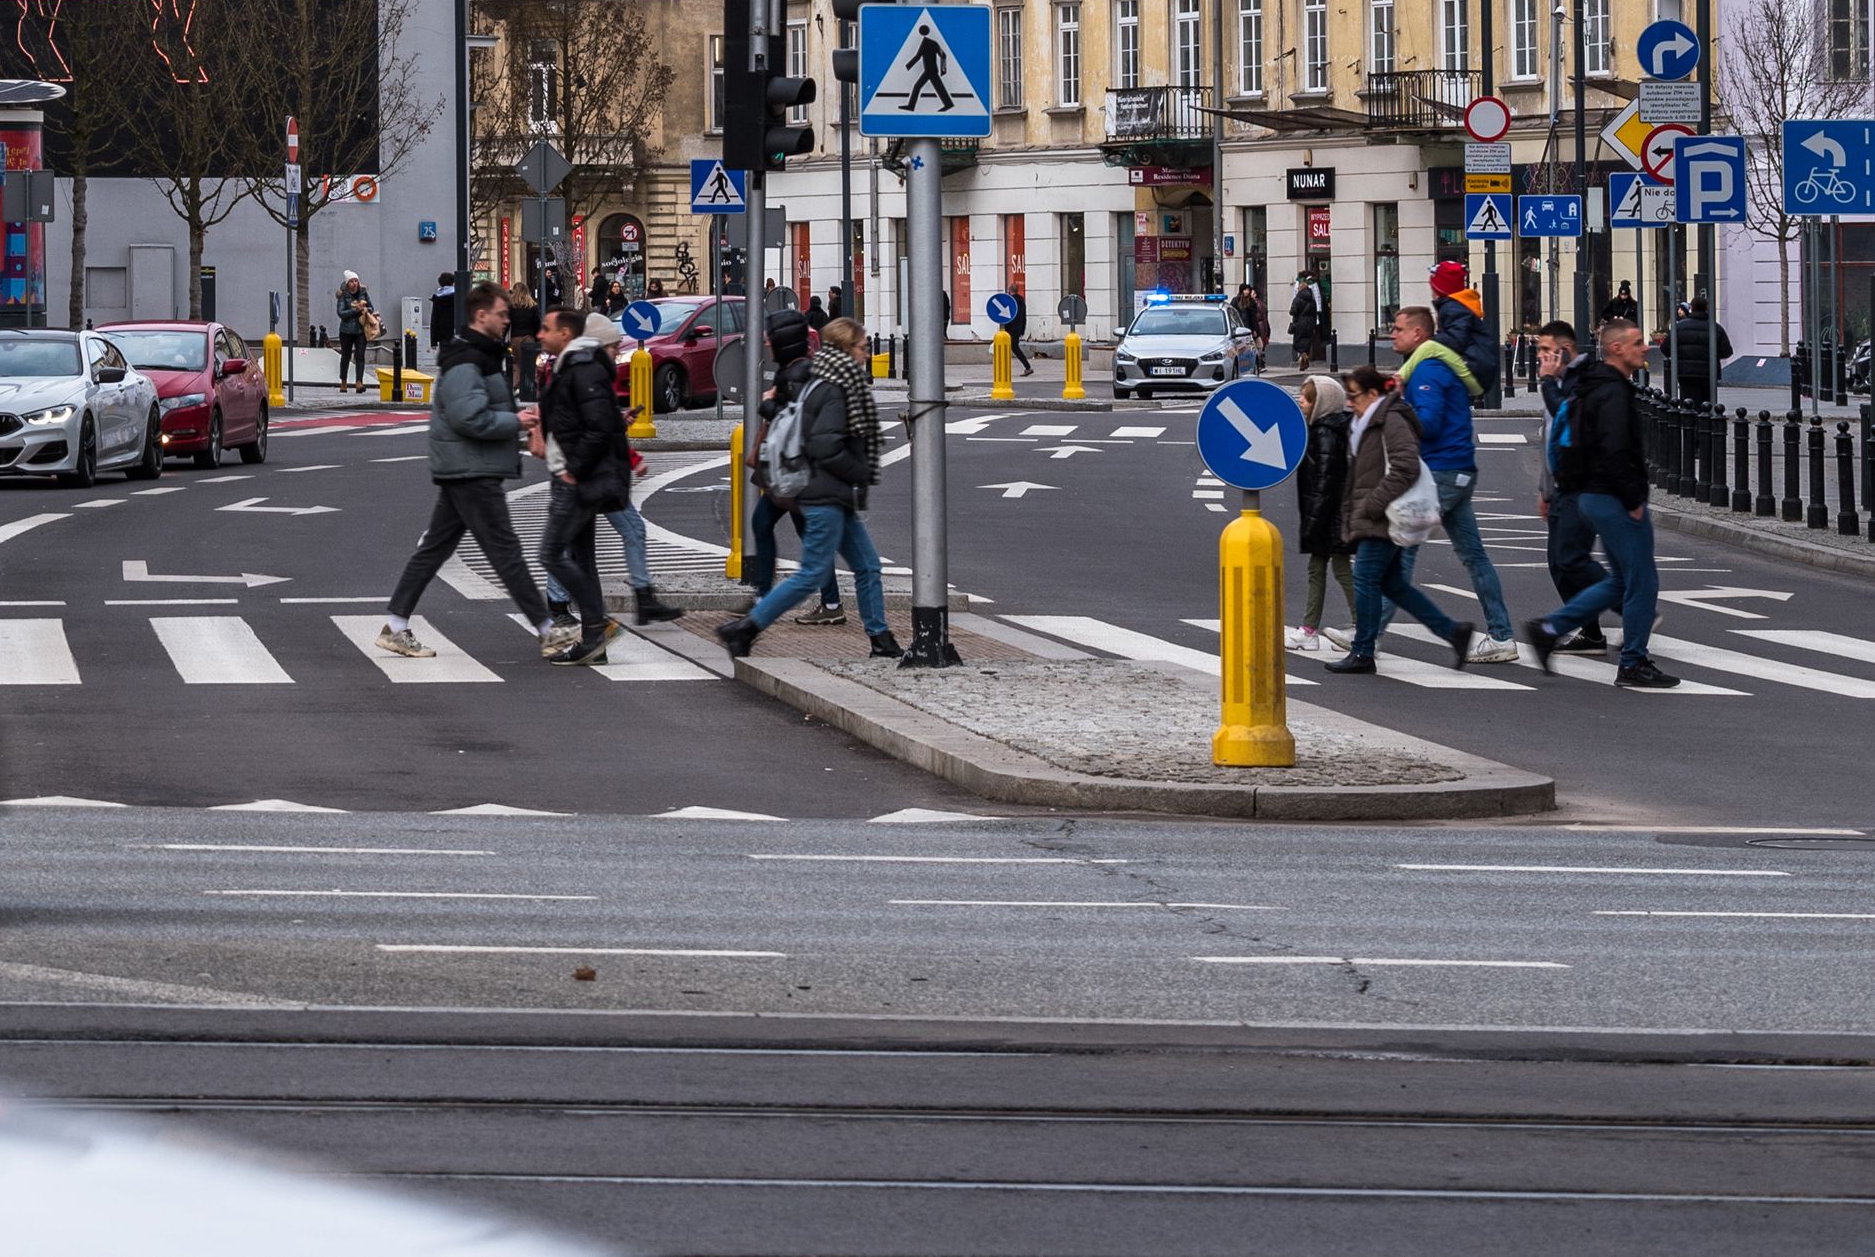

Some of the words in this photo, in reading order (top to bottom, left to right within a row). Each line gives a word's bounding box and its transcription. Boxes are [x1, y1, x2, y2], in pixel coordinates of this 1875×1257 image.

[1153, 173, 1182, 181] Residence
[1292, 173, 1326, 189] NUNAR
[1644, 188, 1660, 197] Nie
[1161, 240, 1190, 248] DETEKTYW
[601, 254, 644, 268] socjologia
[956, 255, 970, 275] SAL
[1011, 254, 1025, 274] SAL
[797, 260, 811, 279] SAL
